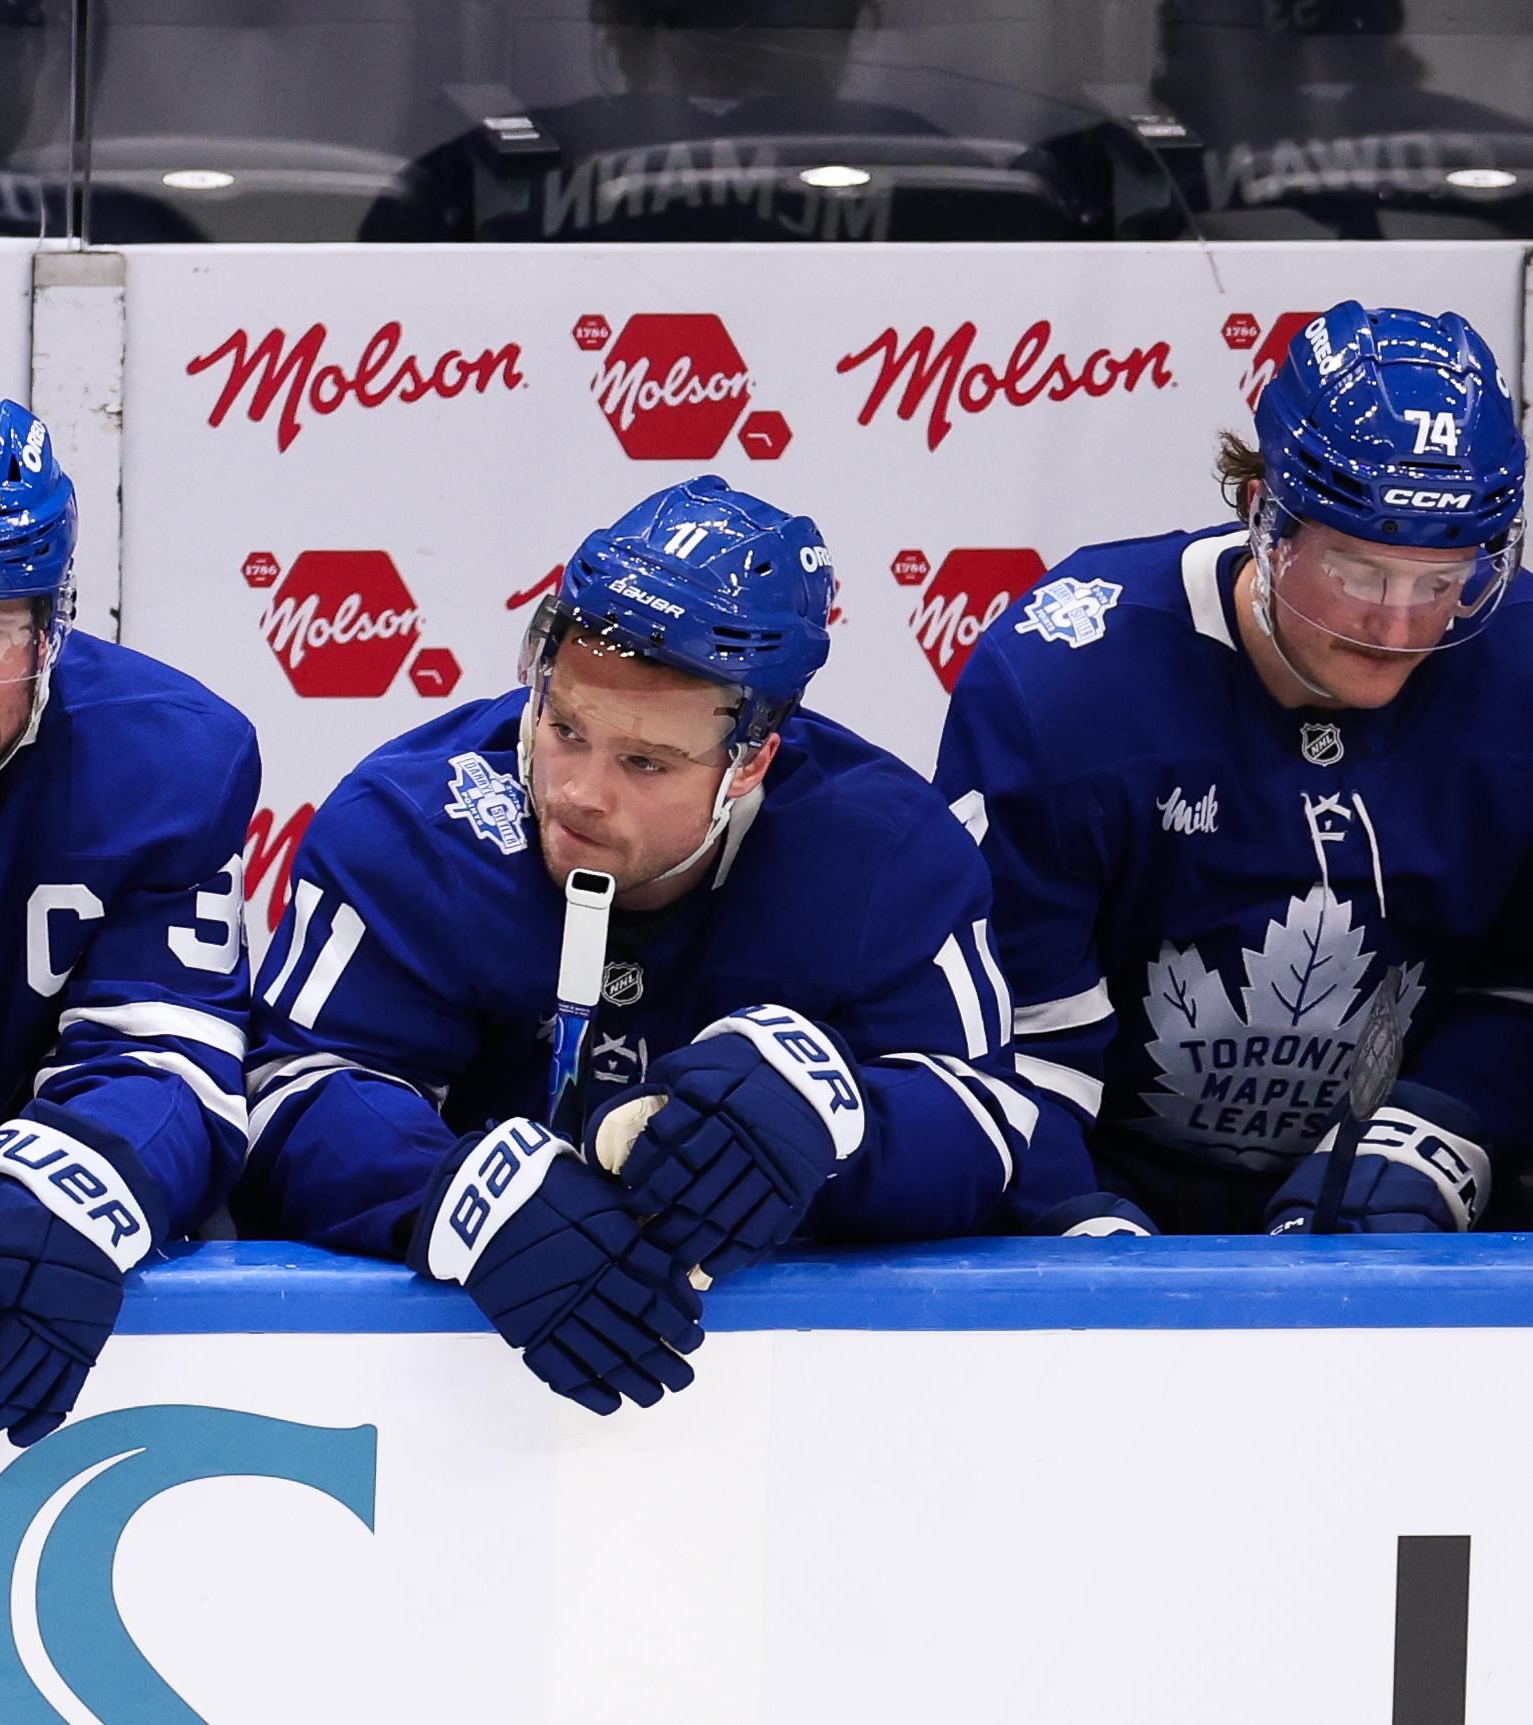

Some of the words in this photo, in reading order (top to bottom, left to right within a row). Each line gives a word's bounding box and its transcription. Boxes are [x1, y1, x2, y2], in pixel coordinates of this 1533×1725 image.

[186, 320, 523, 454] Molson
[589, 355, 751, 432] Molson
[837, 320, 1172, 452] Molson
[1404, 409, 1459, 457] 74
[1383, 488, 1470, 510] CCM
[664, 522, 708, 559] 11
[259, 592, 422, 670] Molson
[608, 579, 685, 619] BAUER
[1310, 731, 1335, 756] NHL
[1157, 784, 1218, 835] Milk
[26, 884, 105, 997] C
[168, 853, 248, 974] 3
[264, 878, 366, 1029] 11
[933, 918, 1012, 1060] 11
[1180, 1035, 1356, 1079] TORONT
[1189, 1103, 1327, 1139] LEAFS
[1201, 1073, 1341, 1108] MAPLE
[449, 1121, 552, 1251] BAU
